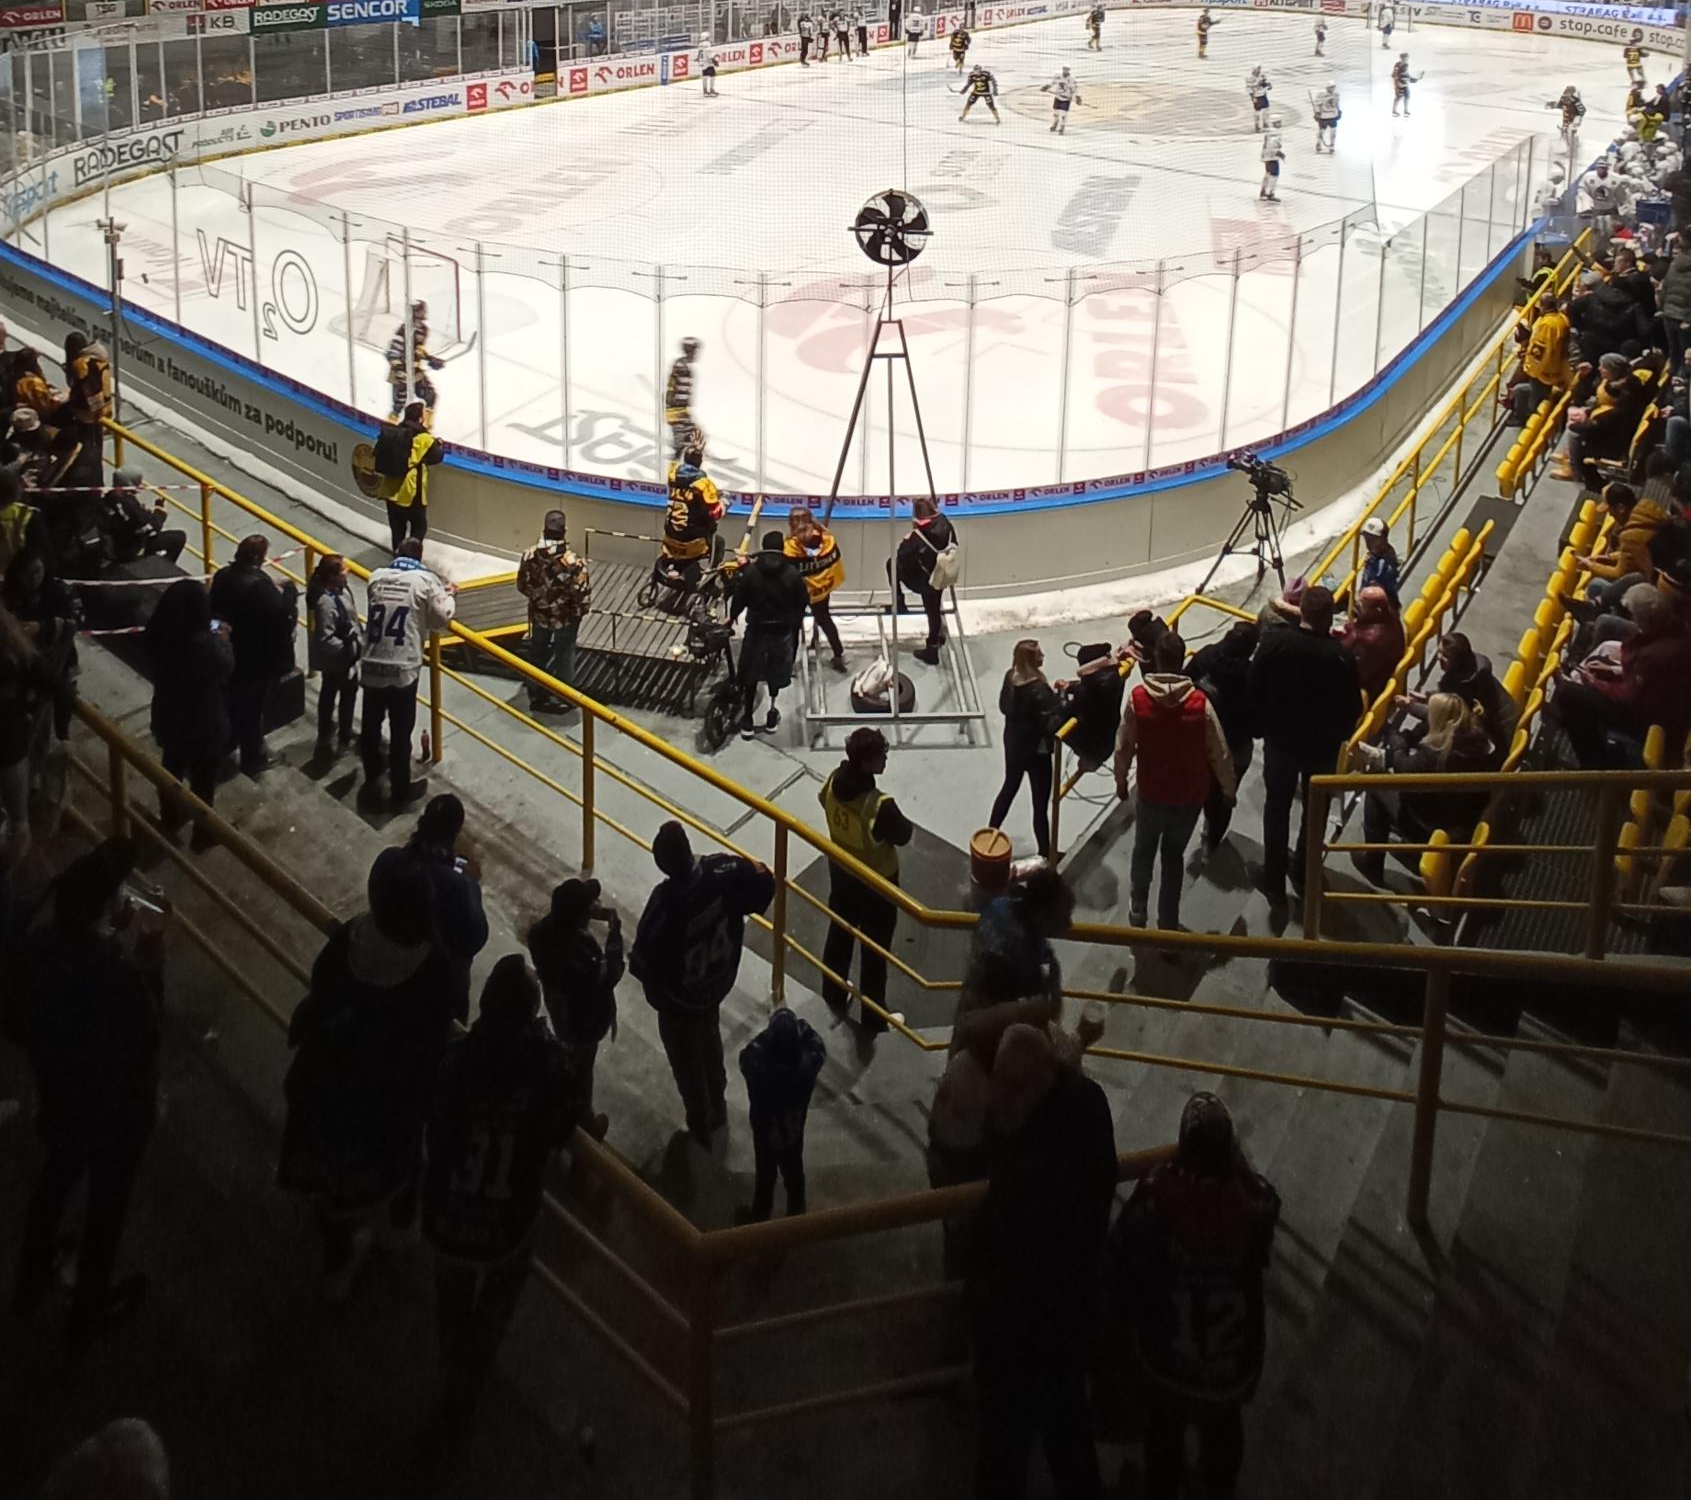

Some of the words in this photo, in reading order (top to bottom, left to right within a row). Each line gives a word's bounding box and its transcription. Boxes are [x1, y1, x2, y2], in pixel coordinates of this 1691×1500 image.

[22, 9, 62, 21] ORLEN
[253, 6, 320, 27] RADEGAST
[210, 16, 235, 29] KB
[1560, 18, 1629, 39] stop.cafe
[616, 63, 656, 80] ORLEN
[279, 114, 331, 133] PENTO
[74, 129, 185, 187] RADEGAST
[157, 359, 166, 374] a
[167, 357, 243, 416] fanouškům
[244, 403, 262, 426] za
[264, 412, 339, 465] podporu!
[577, 474, 607, 486] ORLEN
[1103, 476, 1131, 488] ORLEN
[640, 483, 668, 495] ORLEN
[1043, 485, 1070, 497] ORLEN
[843, 496, 875, 506] ORLEN
[979, 491, 1009, 501] ORLEN
